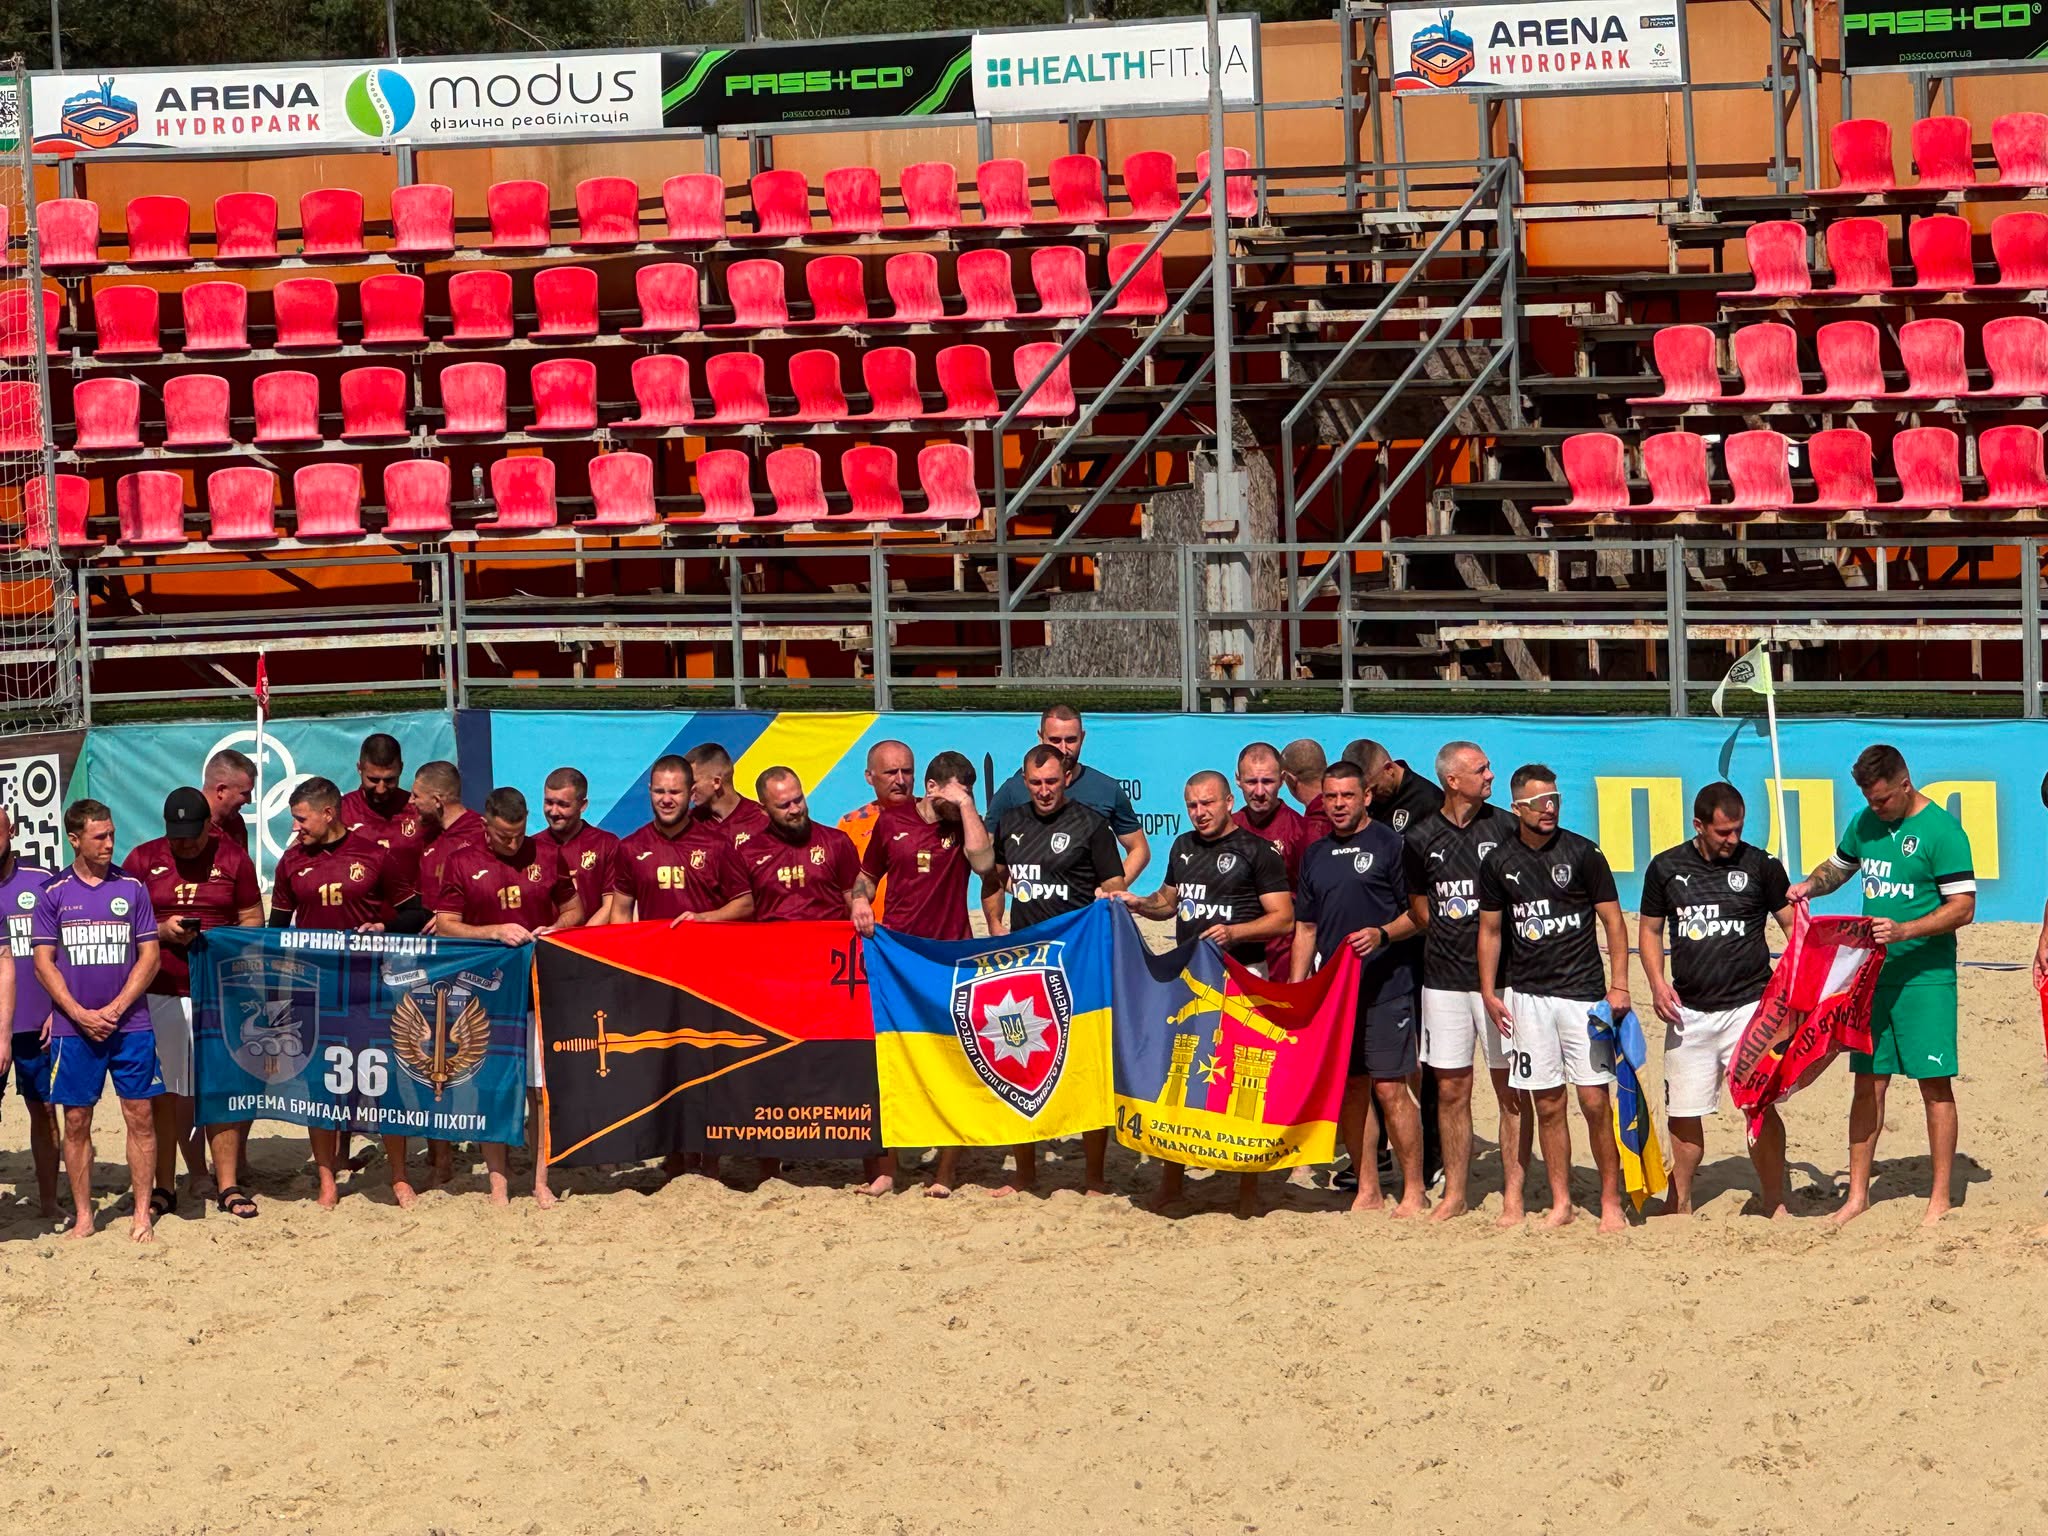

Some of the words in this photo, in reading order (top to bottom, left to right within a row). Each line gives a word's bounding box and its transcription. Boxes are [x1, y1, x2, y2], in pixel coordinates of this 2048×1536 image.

[1488, 14, 1629, 48] ARENA
[1018, 44, 1248, 87] HEALTHFIT.UA
[1489, 49, 1631, 75] HYDROPARK
[1899, 49, 1972, 63] passco.com.ua
[155, 82, 320, 112] ARENA
[429, 63, 637, 109] modus
[156, 113, 321, 137] HYDROPARK
[430, 116, 505, 133] фізична
[511, 109, 630, 130] реабілітація
[782, 107, 851, 121] passco.com.ua
[174, 883, 198, 905] 17
[318, 882, 343, 907] 16
[1436, 879, 1474, 898] МХП
[1512, 899, 1551, 919] МХП
[1676, 904, 1720, 921] МХП
[280, 931, 345, 951] ВІРНИЙ
[973, 944, 1051, 977] КОРД
[953, 990, 977, 1057] ПІДРОЗДІЛ
[323, 1045, 389, 1097] 36
[228, 1094, 286, 1112] ОКРЕМА
[290, 1098, 351, 1122] БРИГАДА
[356, 1106, 430, 1128] МОРСЬКОЇ
[433, 1112, 487, 1131] ПІХОТИ
[754, 1106, 784, 1121] 210
[787, 1103, 873, 1121] ОКРЕМИЙ
[1117, 1104, 1143, 1141] 14
[705, 1122, 822, 1141] ШТУРМОВИЙ
[825, 1125, 872, 1141] ПОЛК
